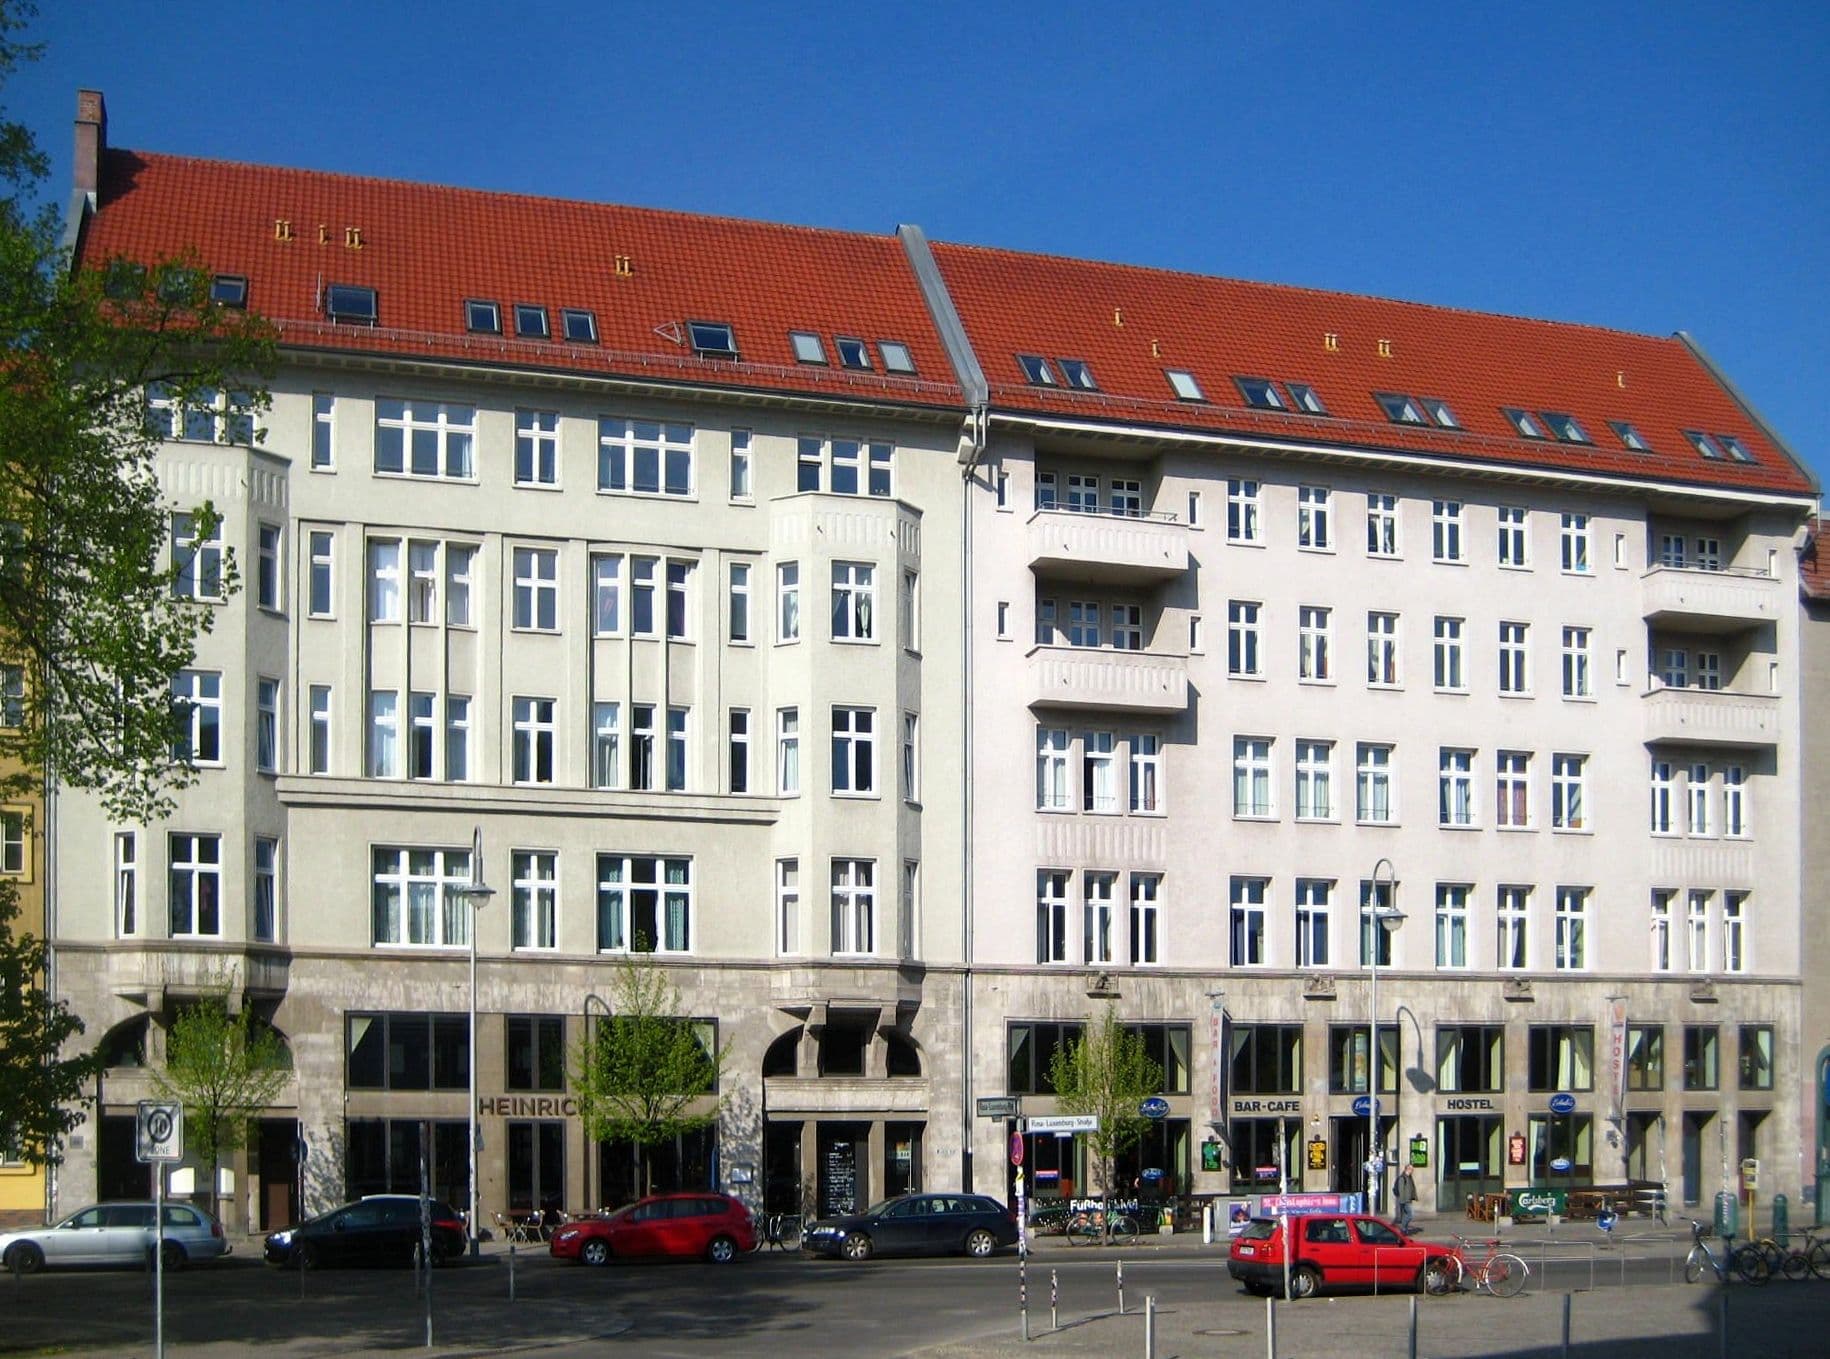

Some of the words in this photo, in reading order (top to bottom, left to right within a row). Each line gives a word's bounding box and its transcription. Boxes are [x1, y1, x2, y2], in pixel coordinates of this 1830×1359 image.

[1234, 1101, 1300, 1112] BAR-CAFE
[1447, 1099, 1494, 1110] HOSTEL
[1518, 1193, 1556, 1208] Carlsberg
